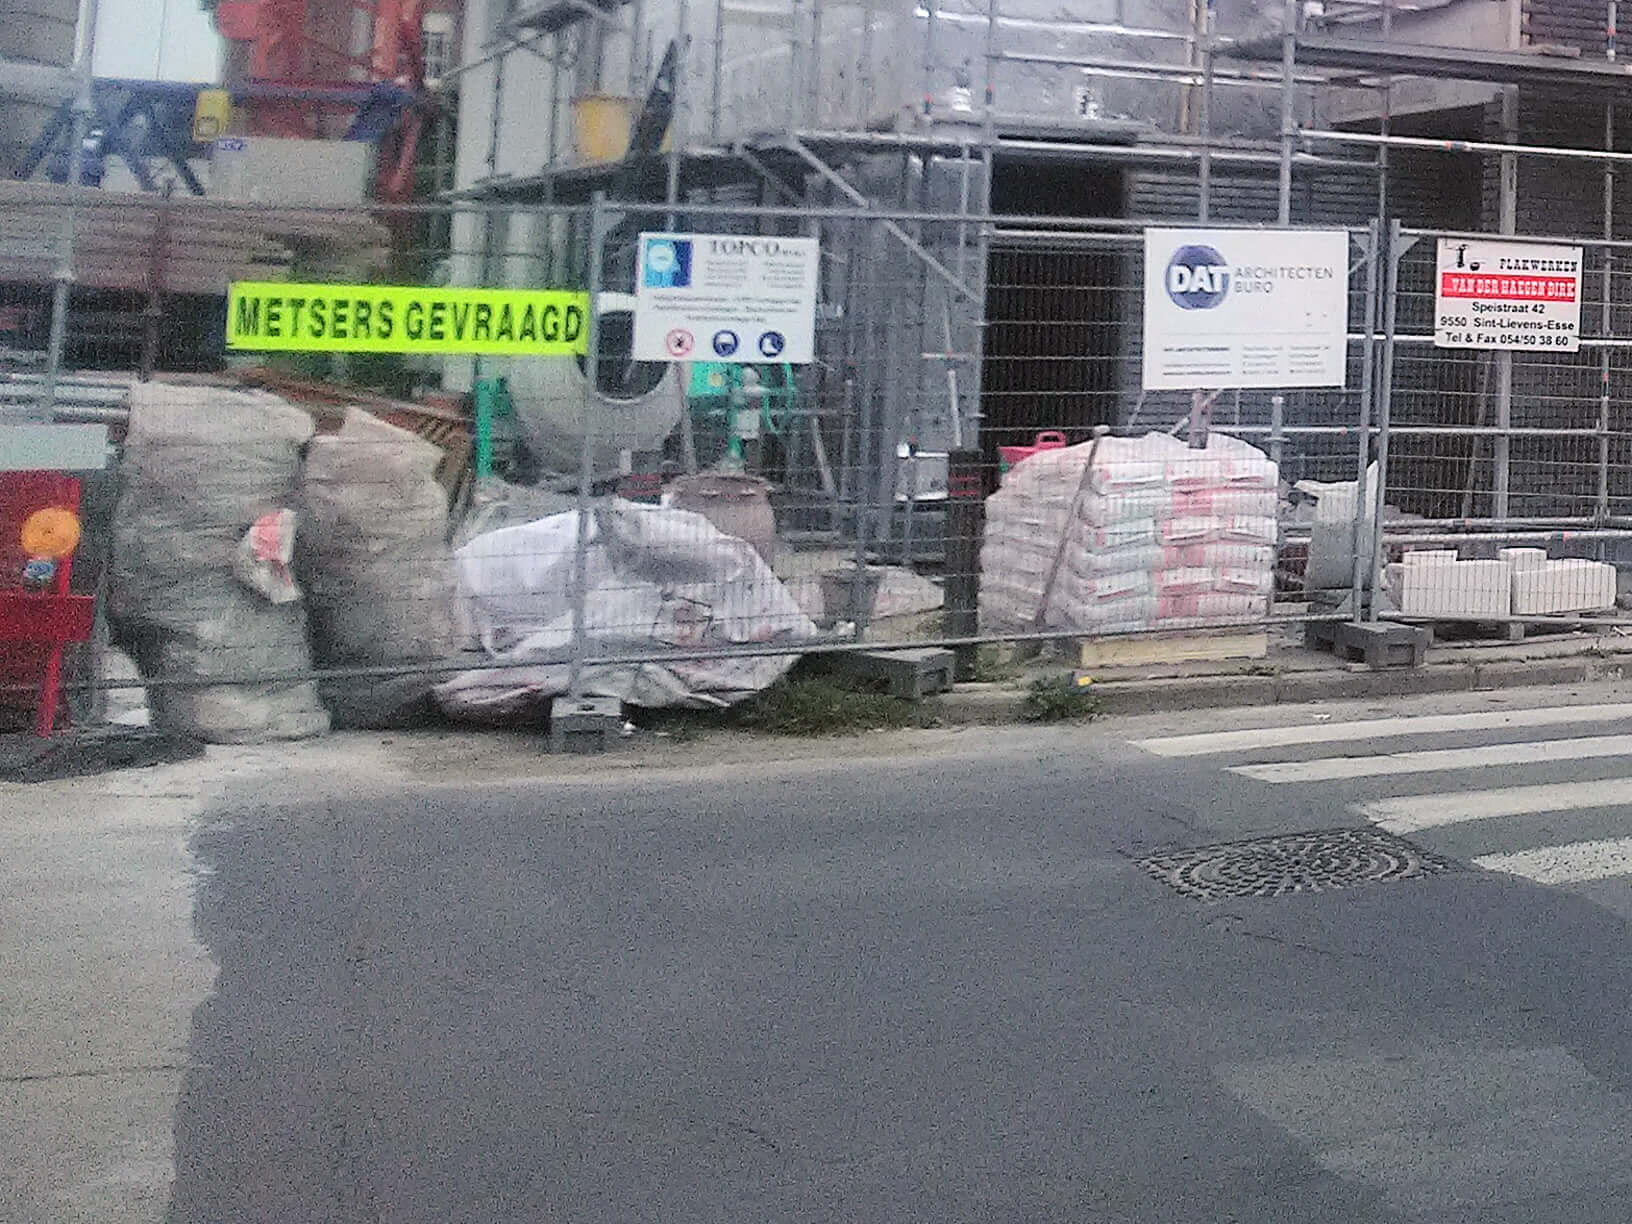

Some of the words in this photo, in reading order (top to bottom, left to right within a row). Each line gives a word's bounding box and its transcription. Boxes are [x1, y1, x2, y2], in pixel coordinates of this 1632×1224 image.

[1499, 258, 1577, 273] PLAKWERKEN
[1169, 264, 1229, 293] DAT
[1234, 266, 1335, 281] ARCHITECTEN
[1235, 280, 1274, 294] BURO
[1452, 277, 1475, 292] VAN
[1477, 278, 1500, 295] DER
[1501, 279, 1547, 297] HAEGEN
[1548, 281, 1576, 298] DIRK
[1471, 301, 1529, 315] Speistraat
[1531, 303, 1546, 314] 42
[236, 295, 395, 340] METSERS
[406, 301, 583, 343] GEVRAAGD
[1439, 315, 1467, 327] 9550
[1473, 317, 1575, 331] Sint-Lievens-Esse
[1445, 331, 1458, 342] Tel
[1465, 333, 1474, 343] &
[1476, 332, 1497, 344] Fax
[1539, 335, 1553, 346] 38
